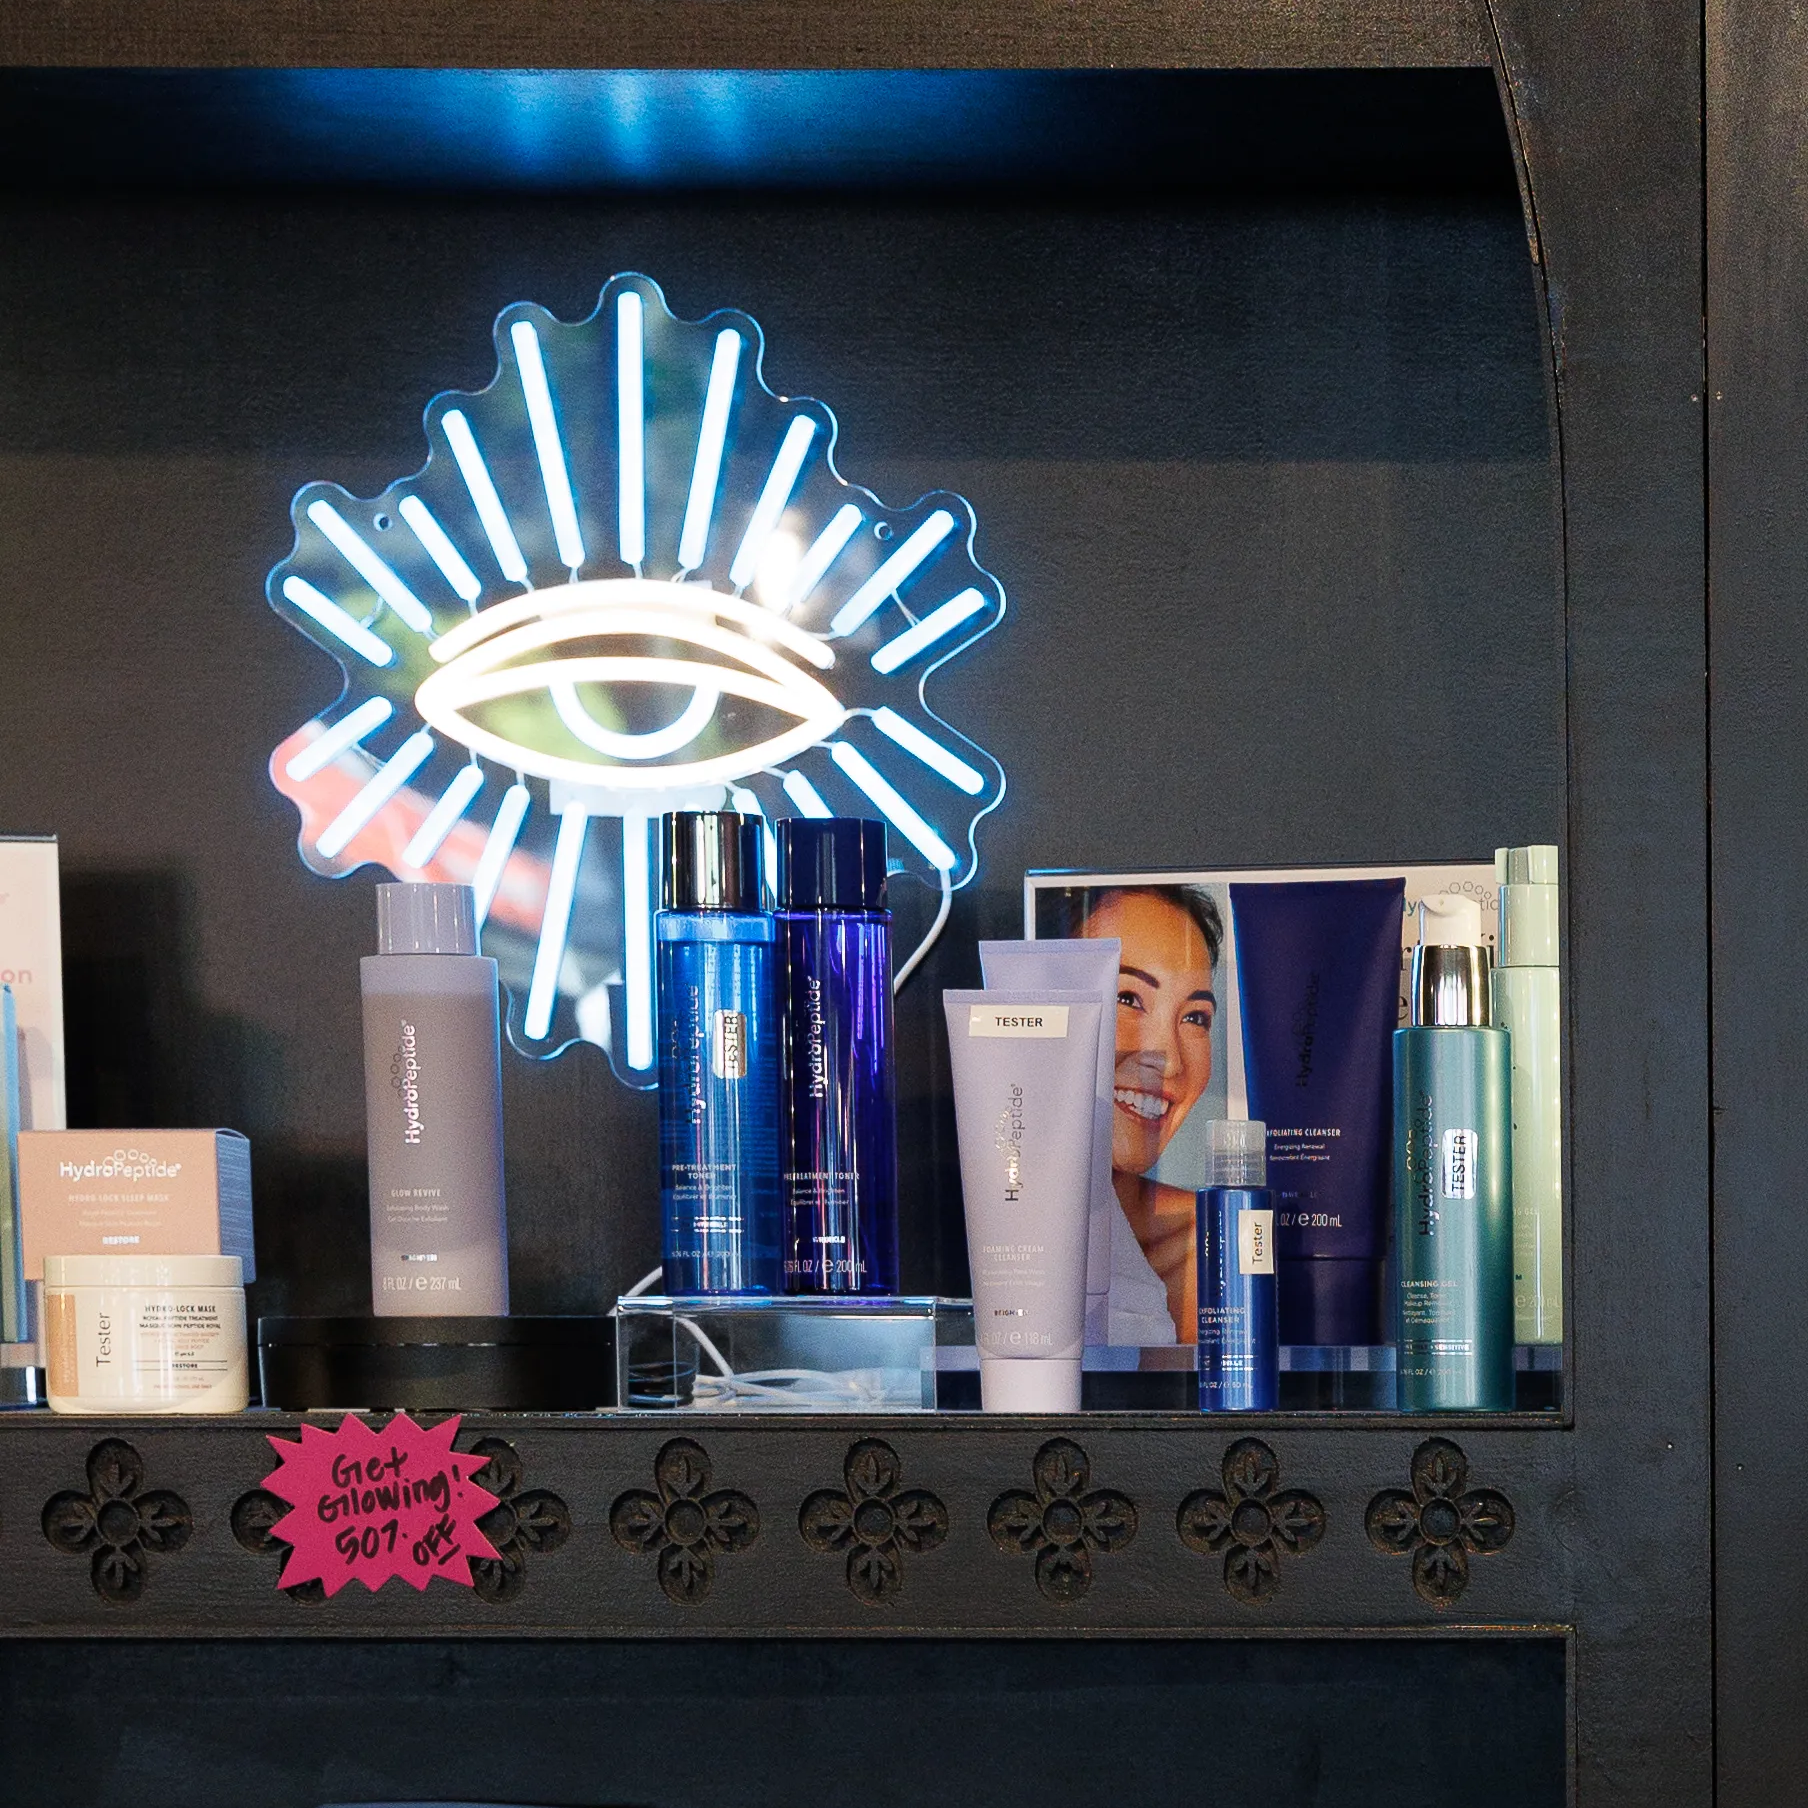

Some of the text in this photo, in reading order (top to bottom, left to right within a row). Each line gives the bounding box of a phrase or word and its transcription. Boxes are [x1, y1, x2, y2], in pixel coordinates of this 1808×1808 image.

[808, 978, 828, 1099] HydroPeptide
[995, 1016, 1043, 1028] TESTER
[403, 1023, 425, 1144] HydroPeptide
[1305, 1128, 1341, 1137] CLEANSER
[60, 1160, 177, 1183] HydroPeptide
[1452, 1134, 1466, 1193] TESTER
[1311, 1213, 1342, 1227] 200 mL
[1252, 1221, 1263, 1265] Tester
[197, 1305, 216, 1313] MASK
[95, 1312, 111, 1367] Tester
[332, 1447, 408, 1488] Get
[318, 1465, 463, 1523] Glowing!
